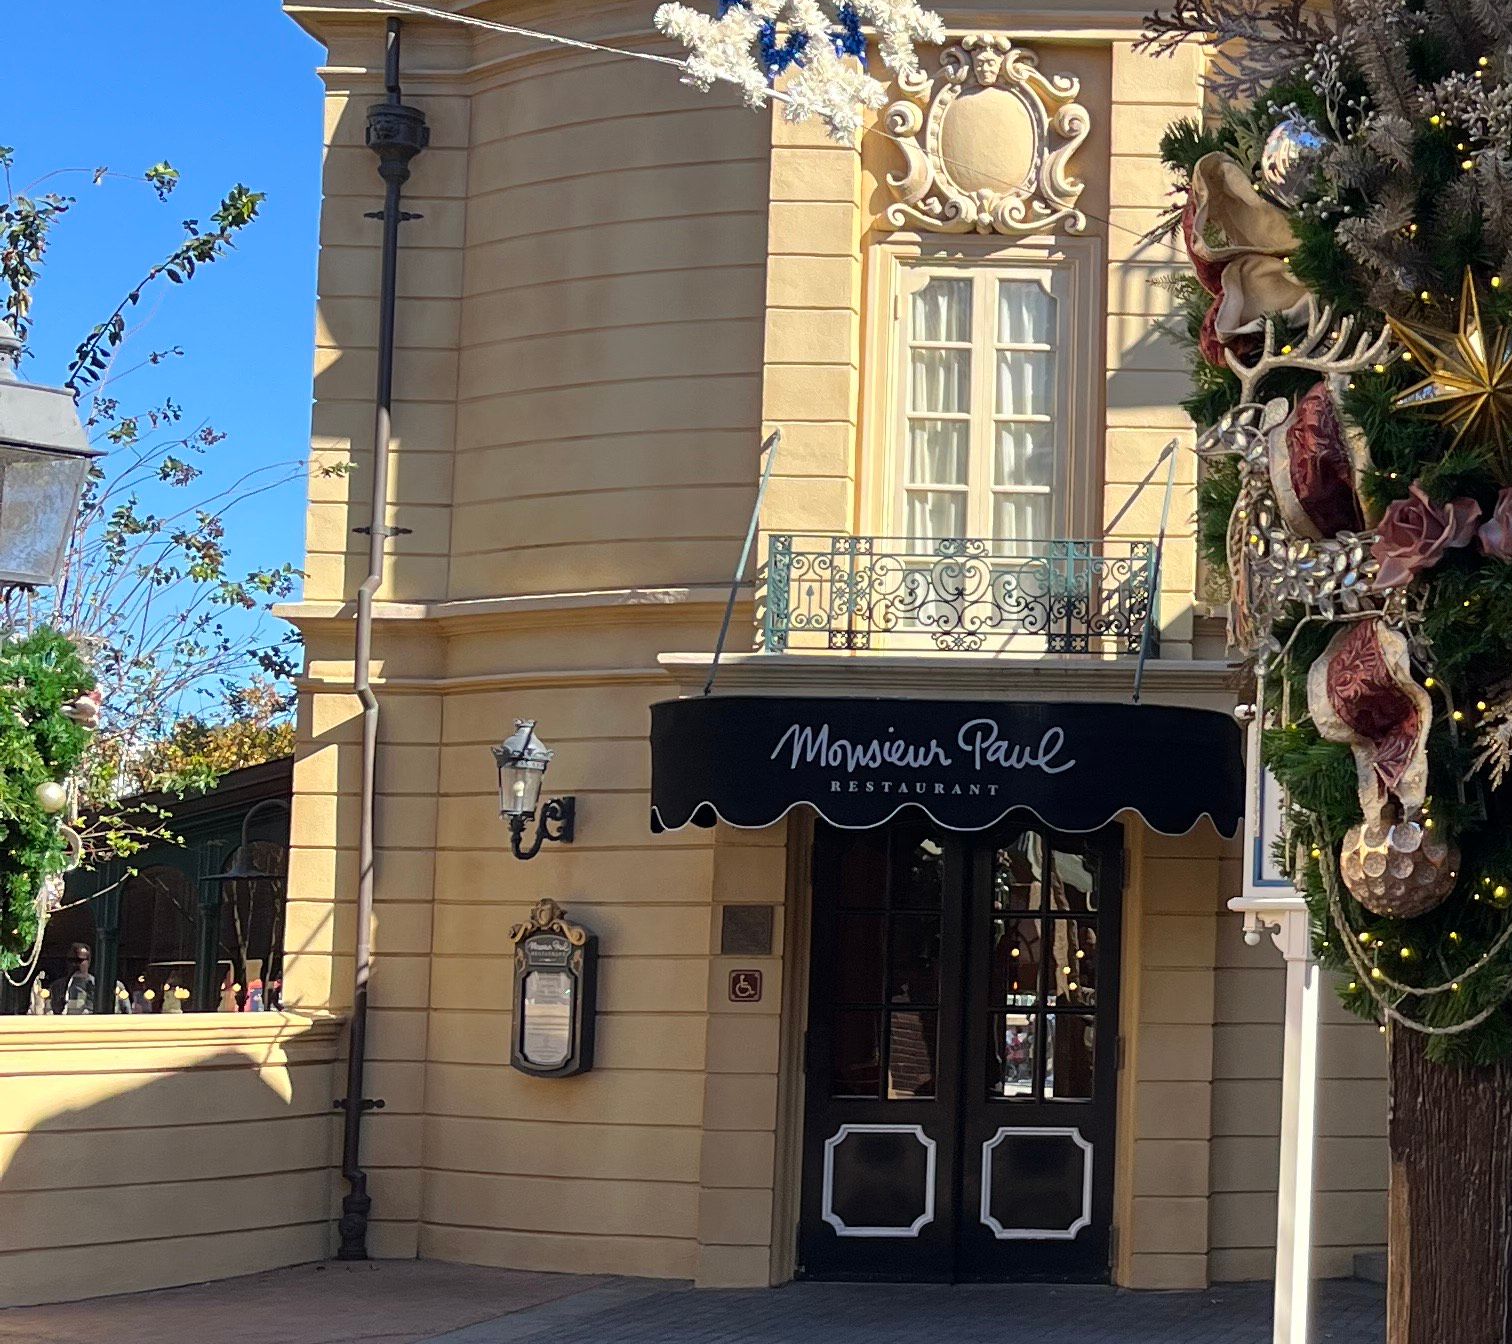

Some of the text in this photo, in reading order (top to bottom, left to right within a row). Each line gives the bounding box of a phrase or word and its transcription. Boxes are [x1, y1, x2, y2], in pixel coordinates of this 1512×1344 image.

[770, 718, 1077, 774] Monsieur Paul
[830, 780, 1000, 796] RESTAURANT
